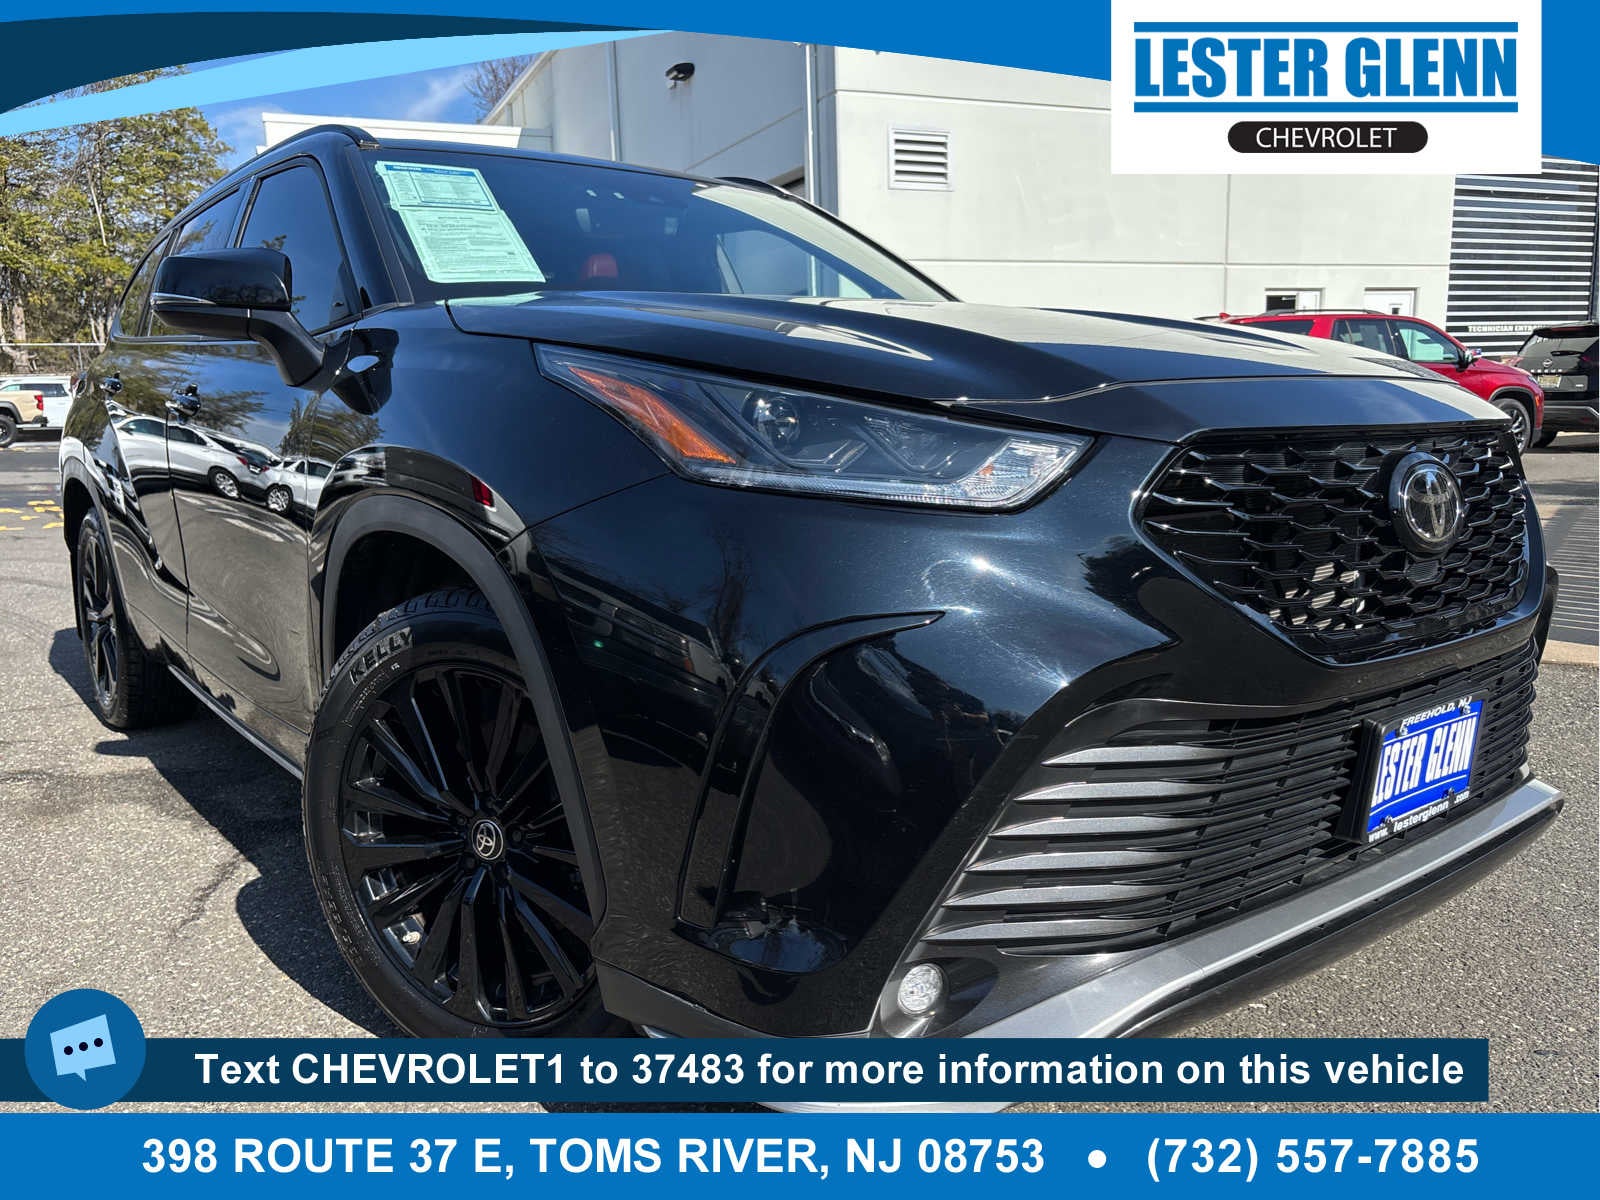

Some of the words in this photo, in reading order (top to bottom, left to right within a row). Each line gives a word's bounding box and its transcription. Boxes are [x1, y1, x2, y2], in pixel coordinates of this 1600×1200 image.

[1468, 325, 1513, 333] TECHNICIAN
[349, 627, 414, 686] KELLY
[1400, 702, 1456, 729] FREEHOLD,
[1371, 732, 1428, 808] LESTER
[1425, 716, 1477, 783] GLENN
